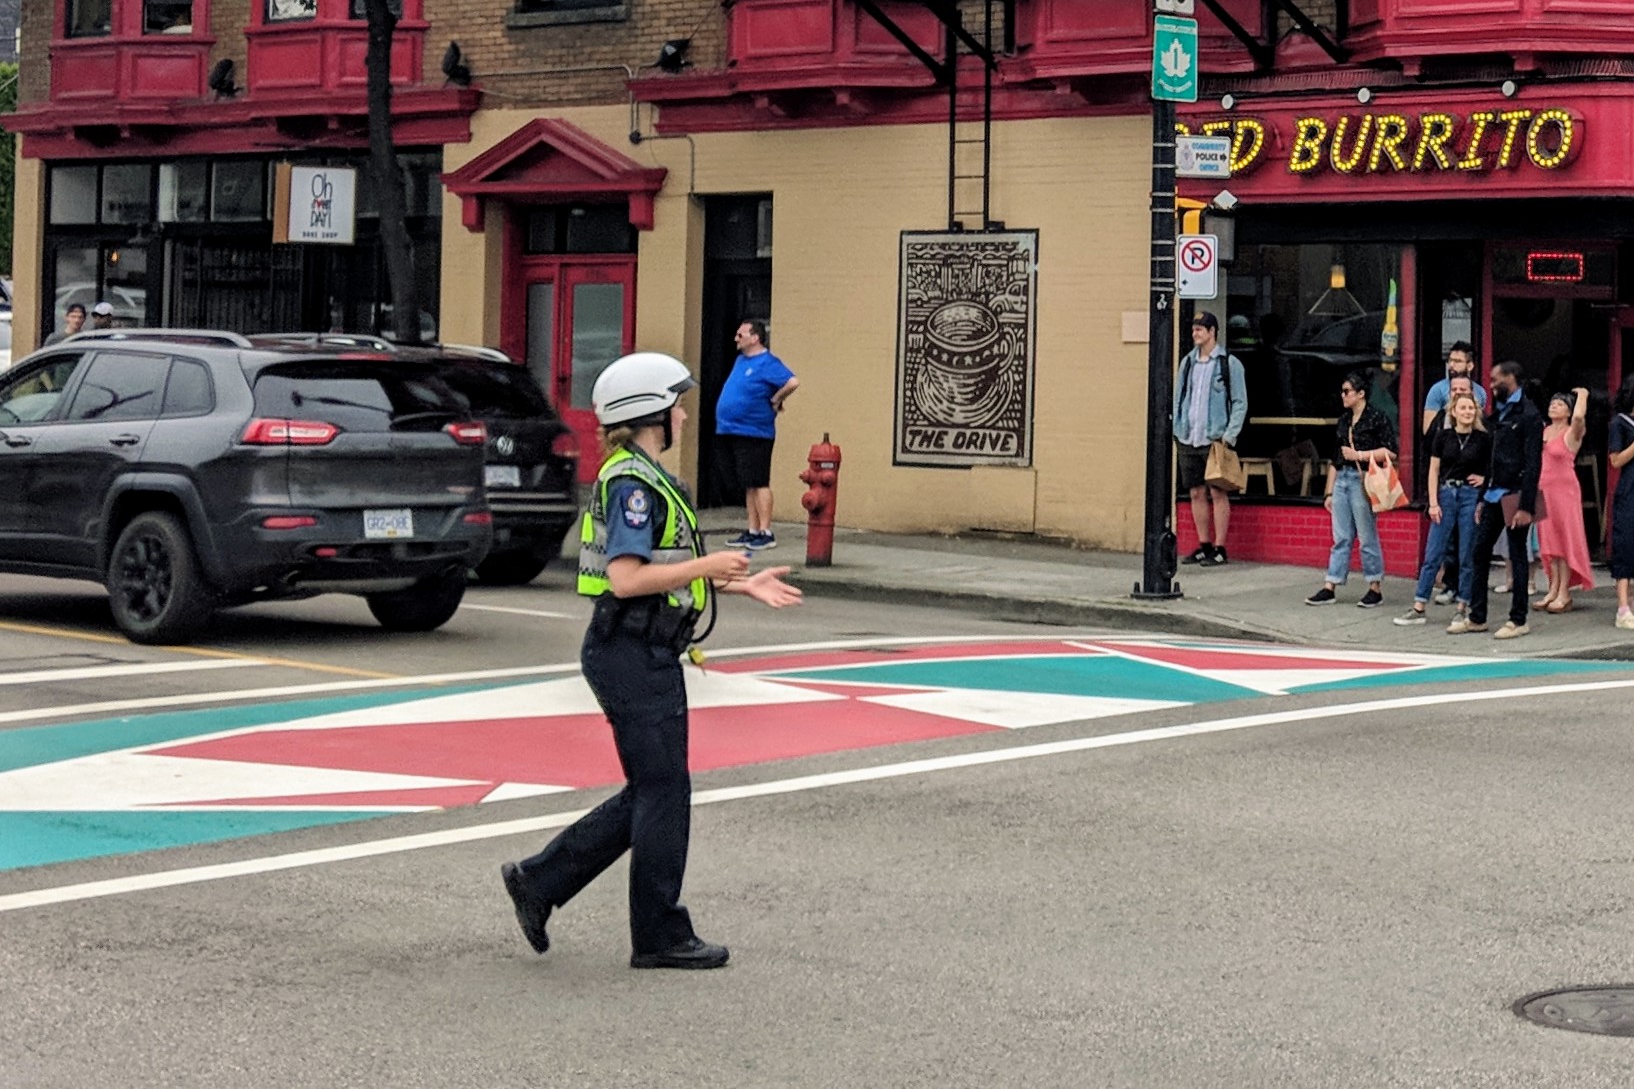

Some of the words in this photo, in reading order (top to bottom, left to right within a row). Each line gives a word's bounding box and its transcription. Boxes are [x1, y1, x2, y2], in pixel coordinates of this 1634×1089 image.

[1287, 109, 1576, 174] BURRITO
[1195, 153, 1219, 161] POLICE
[907, 429, 949, 449] THE
[952, 430, 1015, 452] DRIVE
